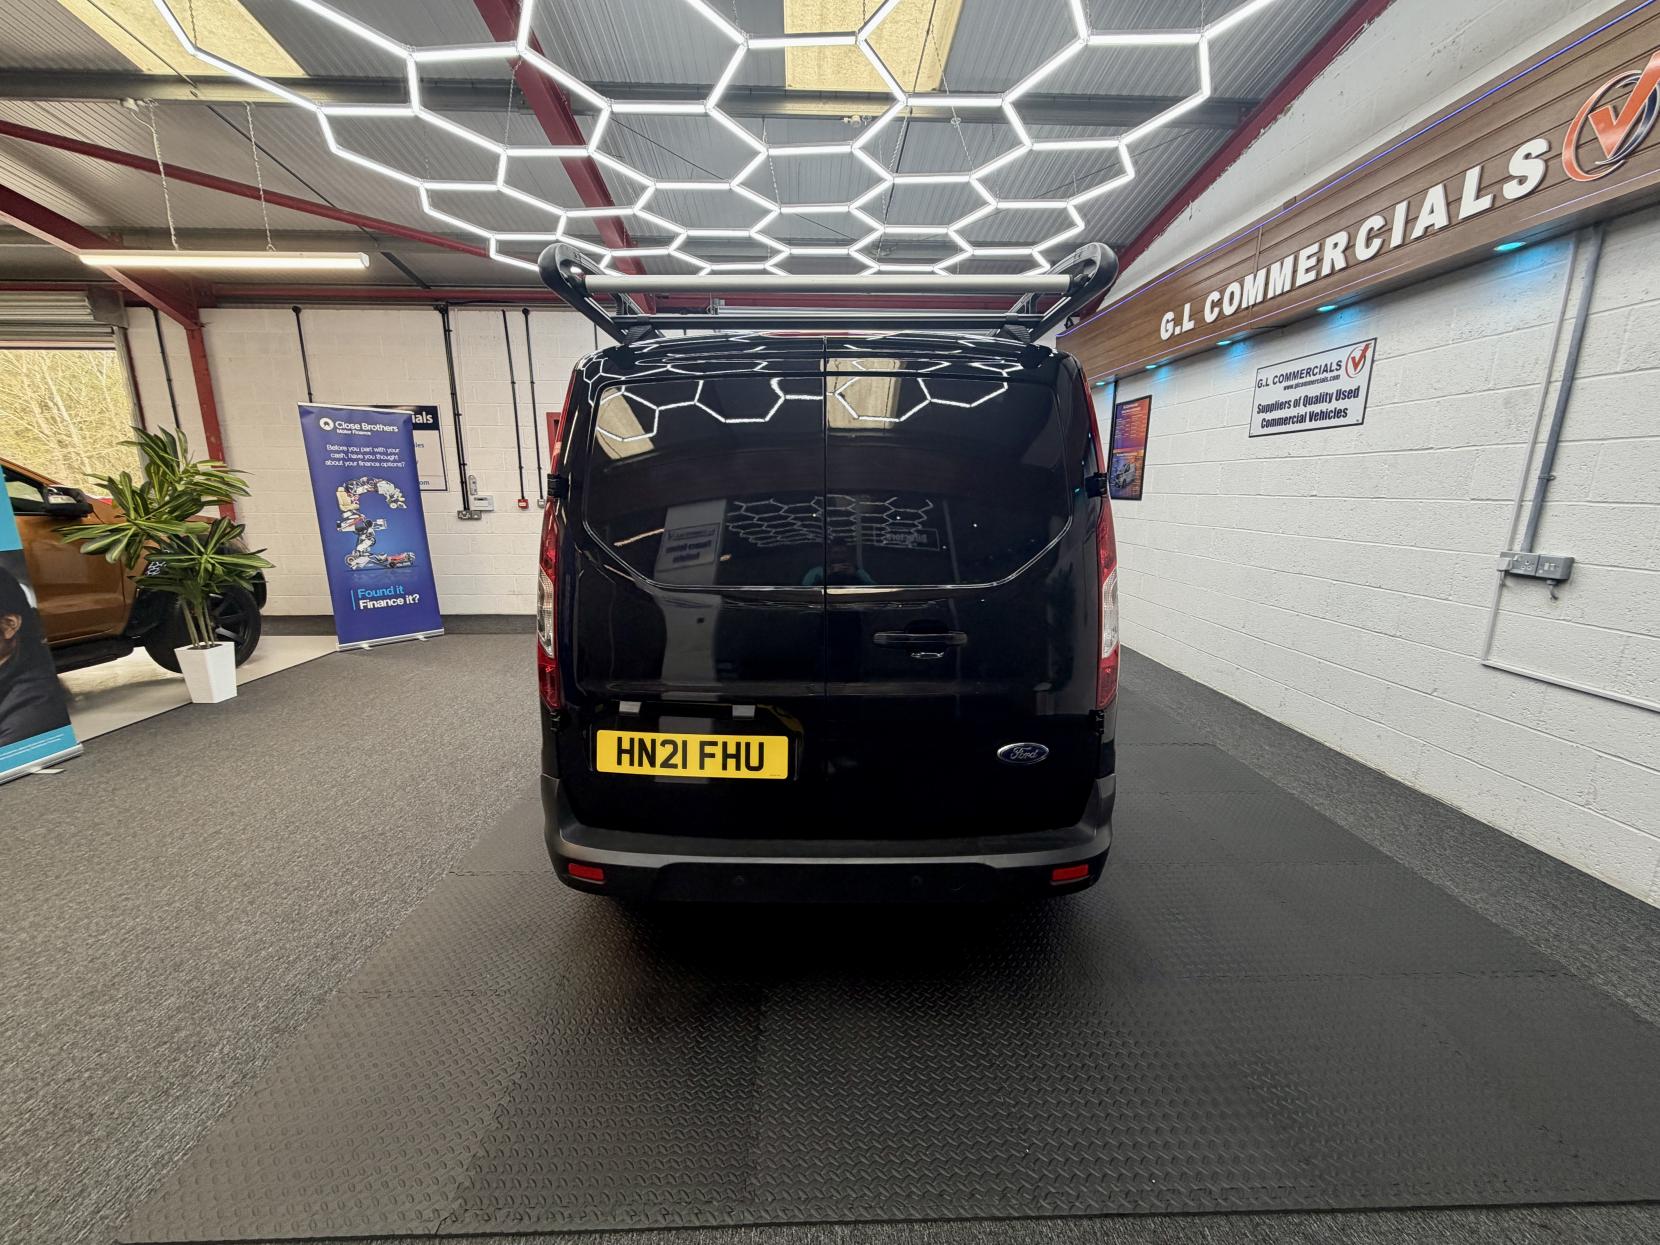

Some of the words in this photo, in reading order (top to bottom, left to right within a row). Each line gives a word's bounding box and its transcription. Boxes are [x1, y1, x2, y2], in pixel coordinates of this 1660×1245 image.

[1160, 301, 1195, 341] G.L
[1203, 138, 1551, 324] COMMERCIALS
[1257, 377, 1270, 389] G.L
[1272, 360, 1342, 386] COMMERCIALS
[1256, 398, 1292, 415] Suppliers
[1293, 396, 1302, 409] of
[1302, 390, 1334, 408] Quality
[1335, 385, 1361, 402] Used
[335, 420, 360, 430] Close
[361, 422, 398, 432] Brothers
[1260, 412, 1307, 429] Commercial
[1308, 407, 1348, 423] Vehicles
[375, 453, 399, 461] thought
[357, 586, 395, 599] Found
[396, 585, 405, 594] it
[359, 597, 404, 610] Finance
[405, 593, 420, 605] it?
[616, 736, 688, 770] HN21
[698, 740, 765, 772] FHU
[1010, 746, 1039, 760] Ford
